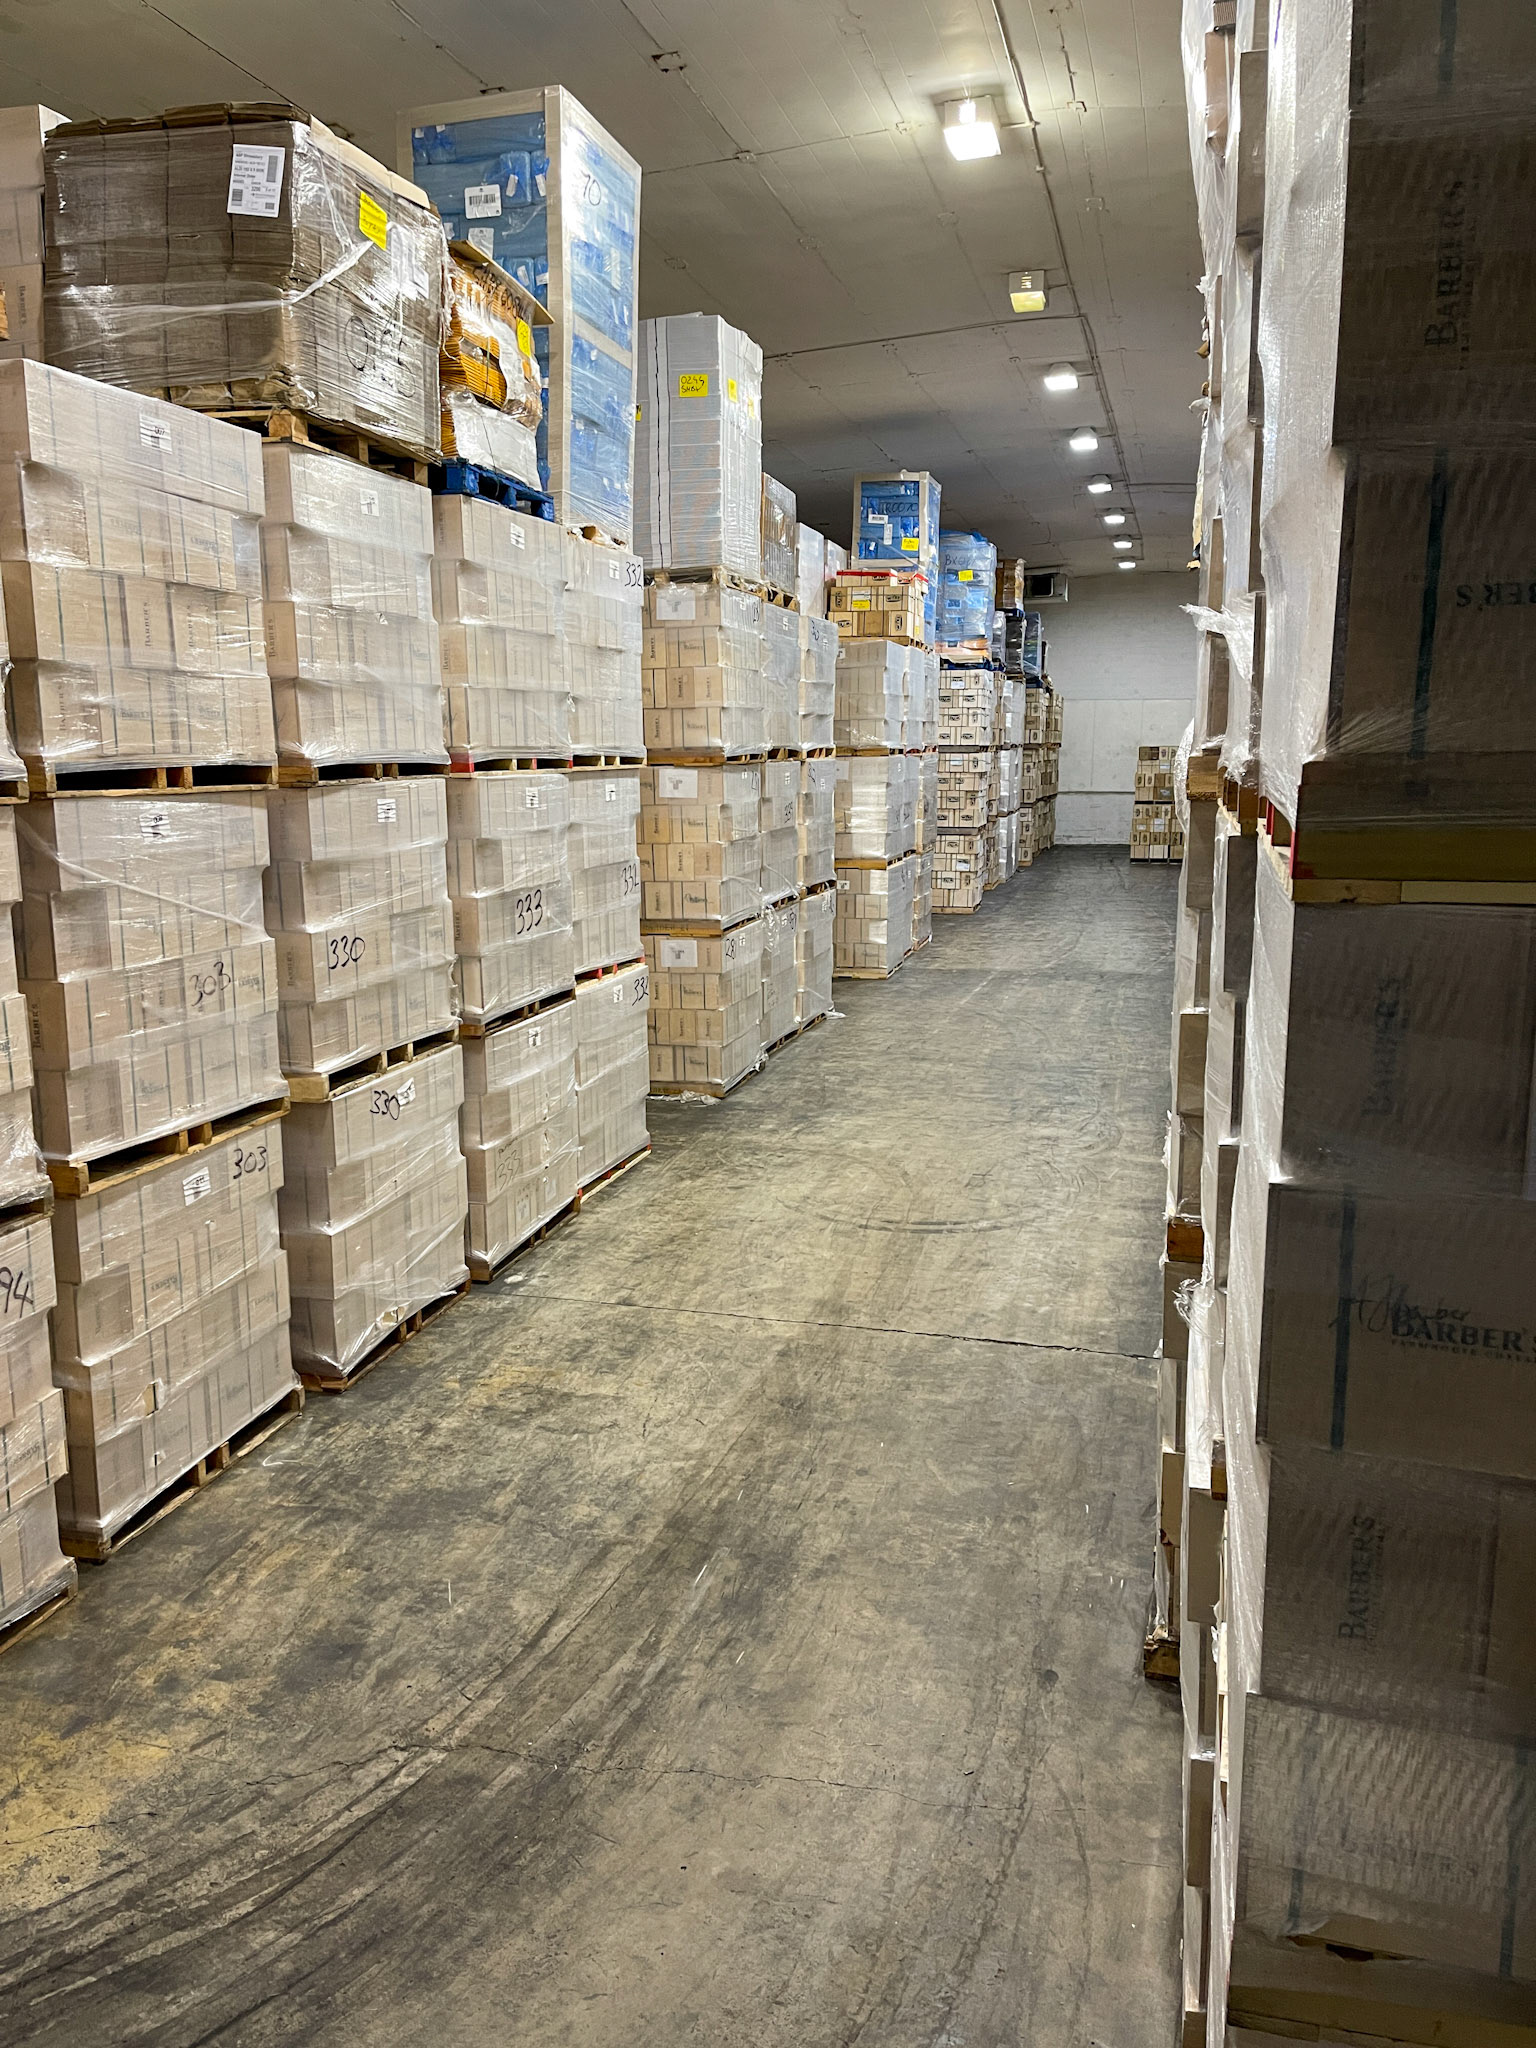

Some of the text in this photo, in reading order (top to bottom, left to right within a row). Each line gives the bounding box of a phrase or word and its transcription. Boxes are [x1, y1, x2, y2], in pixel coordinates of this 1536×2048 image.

[582, 170, 602, 206] 70
[624, 561, 643, 590] 332
[622, 863, 640, 895] 332
[516, 889, 543, 935] 333
[328, 935, 366, 970] 330
[189, 961, 231, 1007] 303
[632, 975, 649, 1006] 332
[369, 1090, 401, 1121] 330
[233, 1146, 268, 1180] 303
[1391, 1312, 1536, 1358] BARBER'
